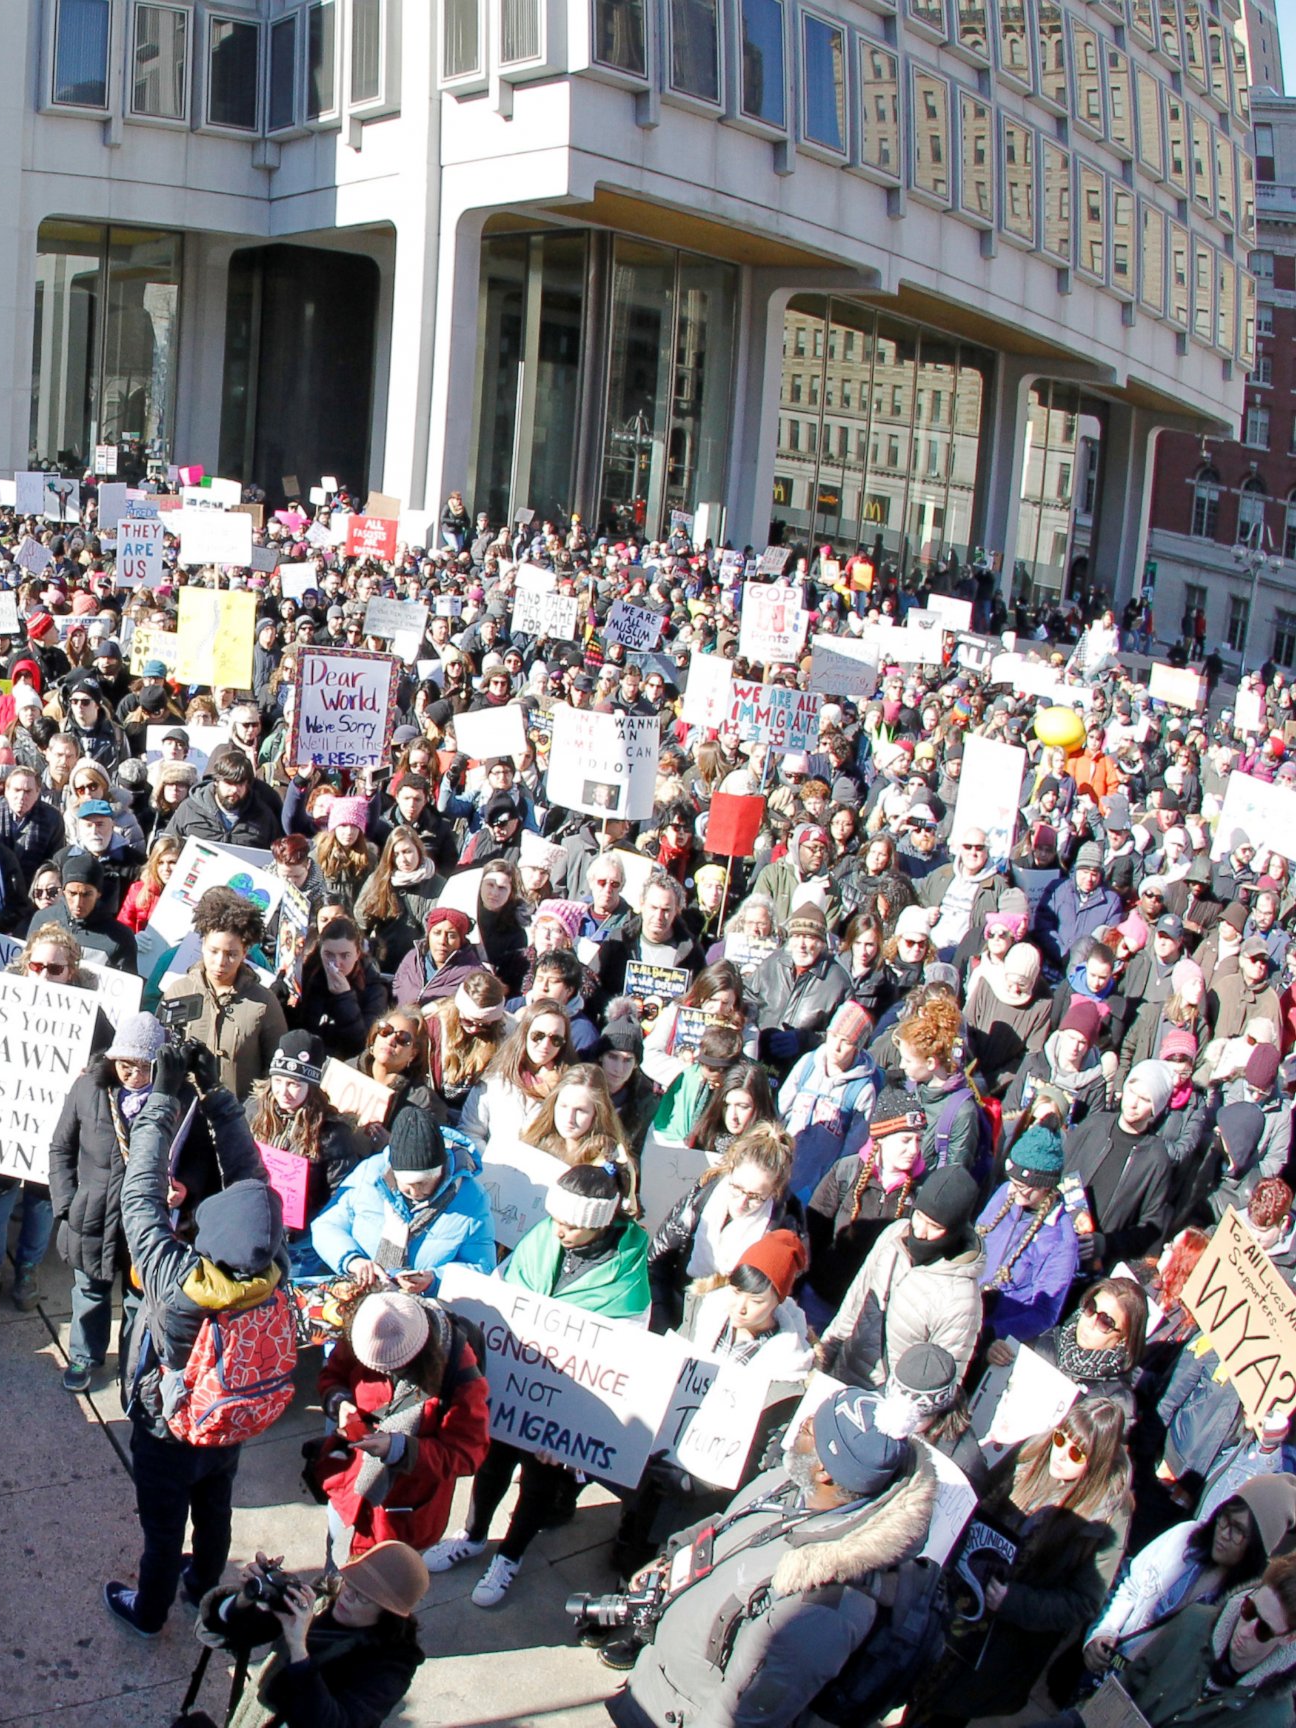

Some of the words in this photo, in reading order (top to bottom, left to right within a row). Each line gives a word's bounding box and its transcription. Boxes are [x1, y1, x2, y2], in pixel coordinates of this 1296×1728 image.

[122, 524, 161, 538] THEY
[365, 519, 385, 531] ALL
[123, 543, 154, 556] ARE
[123, 559, 147, 579] US
[518, 590, 541, 607] AND
[545, 594, 574, 611] THEN
[749, 585, 797, 603] GOP
[516, 604, 541, 621] THEY
[544, 610, 573, 626] CAME
[621, 603, 636, 616] WE
[637, 611, 658, 626] ARE
[624, 616, 641, 630] ALL
[522, 619, 541, 634] FOR
[547, 623, 567, 638] ME
[608, 618, 651, 642] MUSLIM
[616, 633, 645, 649] NOW
[305, 658, 367, 689] Dear
[320, 685, 381, 714] World,
[733, 682, 763, 703] WE
[769, 689, 793, 710] ARE
[796, 693, 818, 714] ALL
[305, 715, 336, 734] We're
[338, 714, 377, 739] Sorry
[614, 718, 659, 729] WANNA
[731, 700, 821, 736] IMMIGRANTS
[299, 735, 329, 751] We'll
[335, 735, 355, 750] Fix
[361, 737, 385, 752] This
[617, 730, 638, 741] AN
[654, 980, 685, 993] DEFEND
[30, 983, 94, 1016] JAWN
[20, 1010, 83, 1040] YOUR
[12, 1079, 55, 1106] JAW
[8, 1113, 47, 1135] MY
[1228, 1213, 1242, 1243] To
[1257, 1264, 1287, 1313] Lives
[509, 1296, 613, 1349] FIGHT
[505, 1372, 562, 1408] NOT
[487, 1398, 618, 1471] MIGRANTS.
[676, 1405, 742, 1463] Trump
